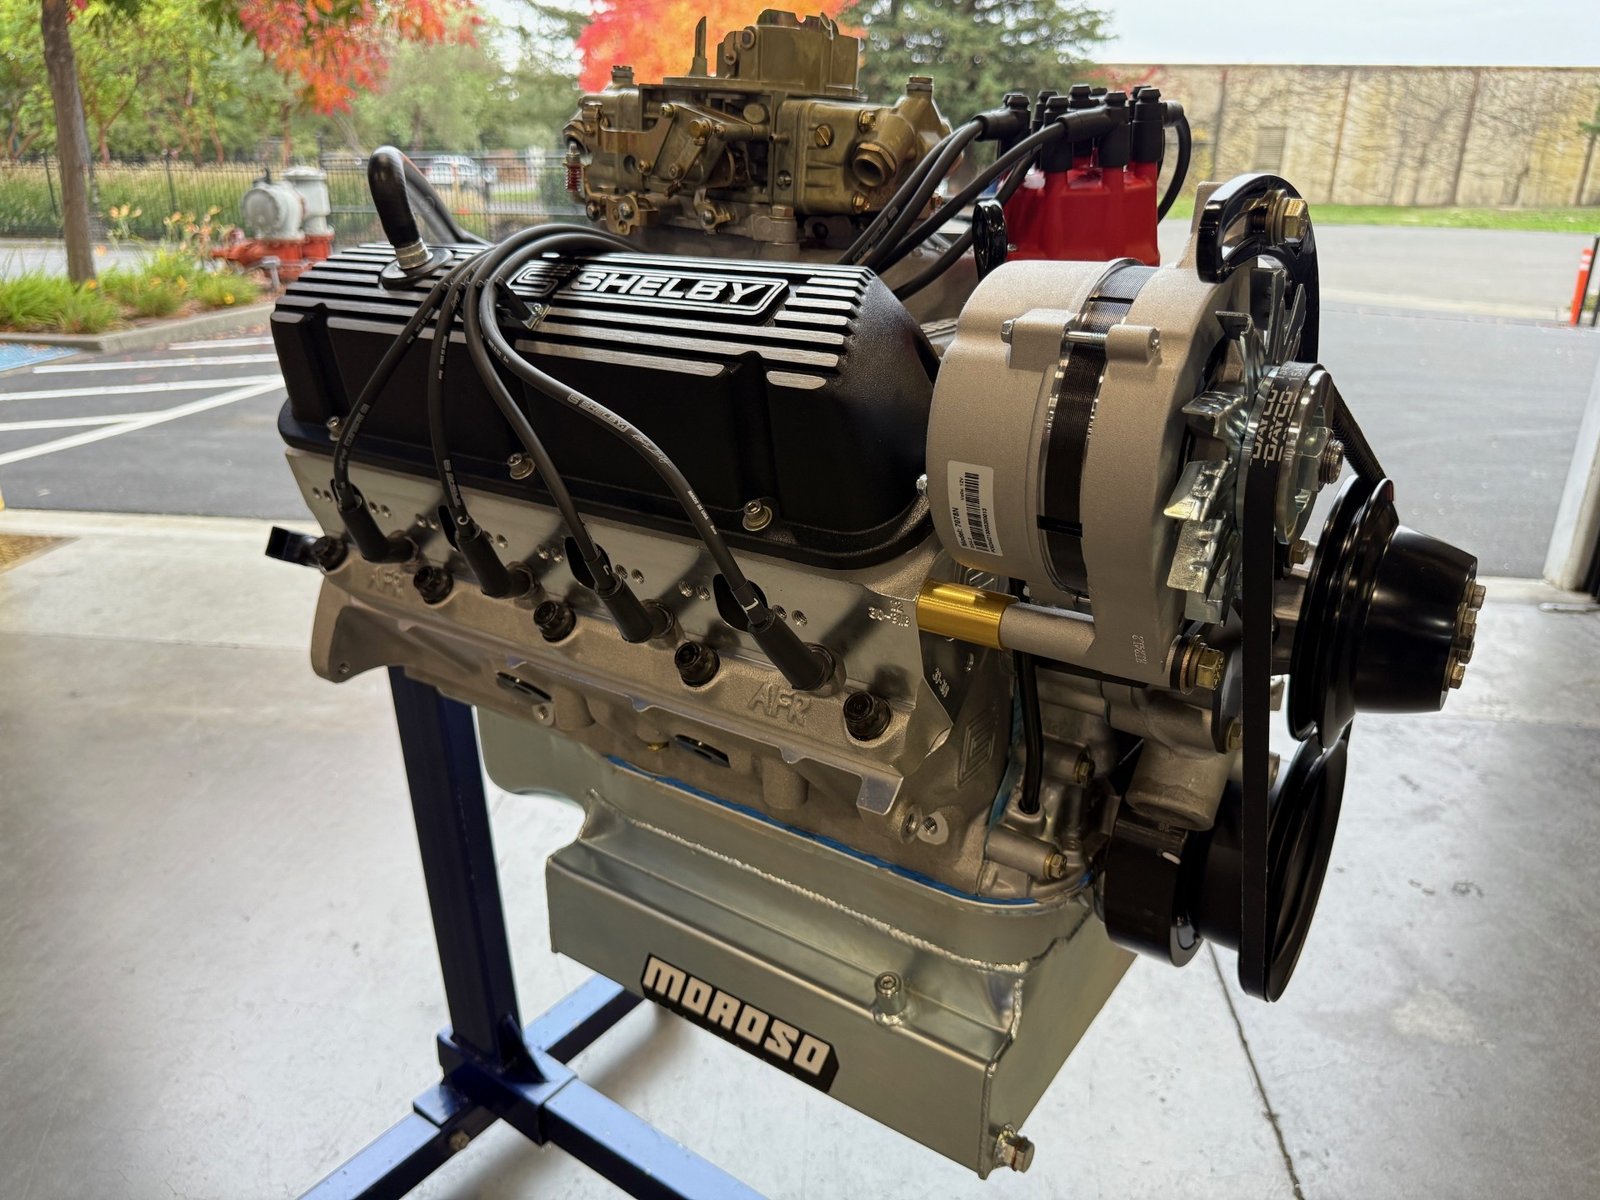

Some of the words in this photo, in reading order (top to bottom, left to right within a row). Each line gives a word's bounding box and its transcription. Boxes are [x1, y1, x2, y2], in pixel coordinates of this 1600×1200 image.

[570, 272, 766, 303] SHELBY
[747, 681, 812, 727] AFR
[642, 956, 831, 1076] MOROSO
